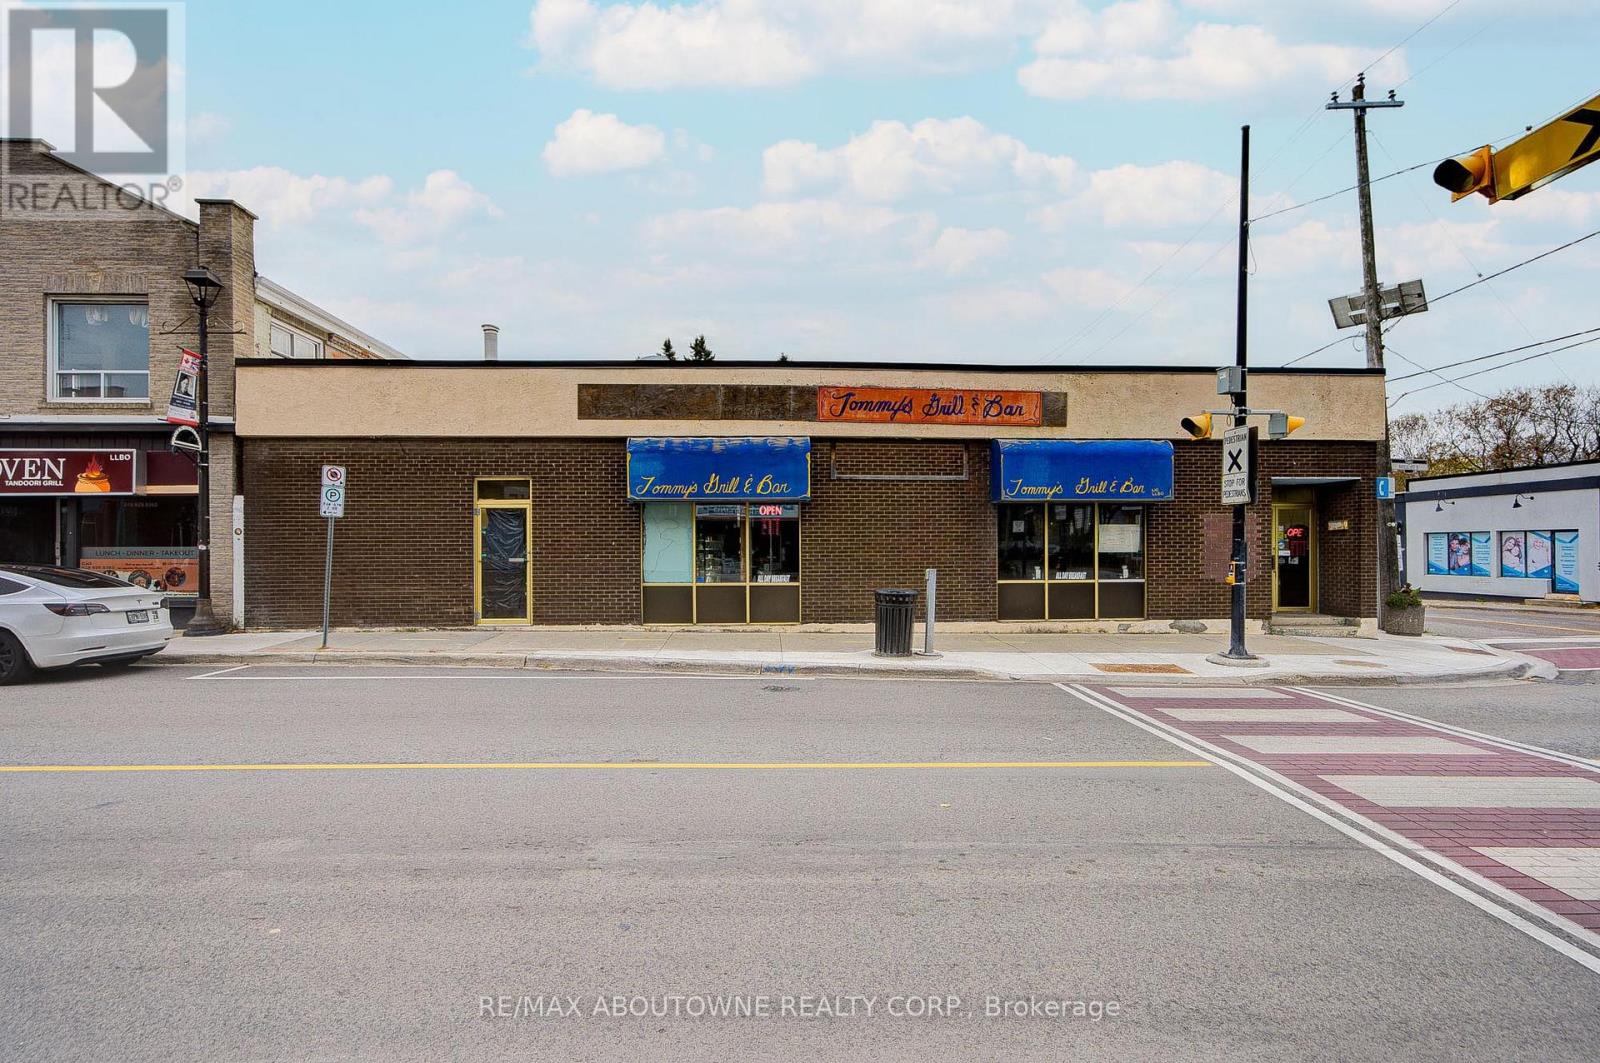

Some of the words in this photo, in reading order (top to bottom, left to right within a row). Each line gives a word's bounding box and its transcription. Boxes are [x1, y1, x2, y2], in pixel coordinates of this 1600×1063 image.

[829, 391, 913, 420] Tommy's
[921, 392, 966, 419] Grill
[983, 394, 1026, 418] Bar
[1224, 433, 1247, 444] PEDESTRIAN
[0, 458, 66, 480] VEN
[635, 475, 698, 499] Tommy's
[703, 473, 740, 494] Grill
[756, 474, 792, 494] Bar
[1006, 478, 1064, 499] Tommy's
[1075, 477, 1108, 495] Grill
[1120, 477, 1146, 494] Bar
[1223, 479, 1235, 488] STOP
[1236, 477, 1246, 487] FOR
[759, 505, 783, 515] OPEN
